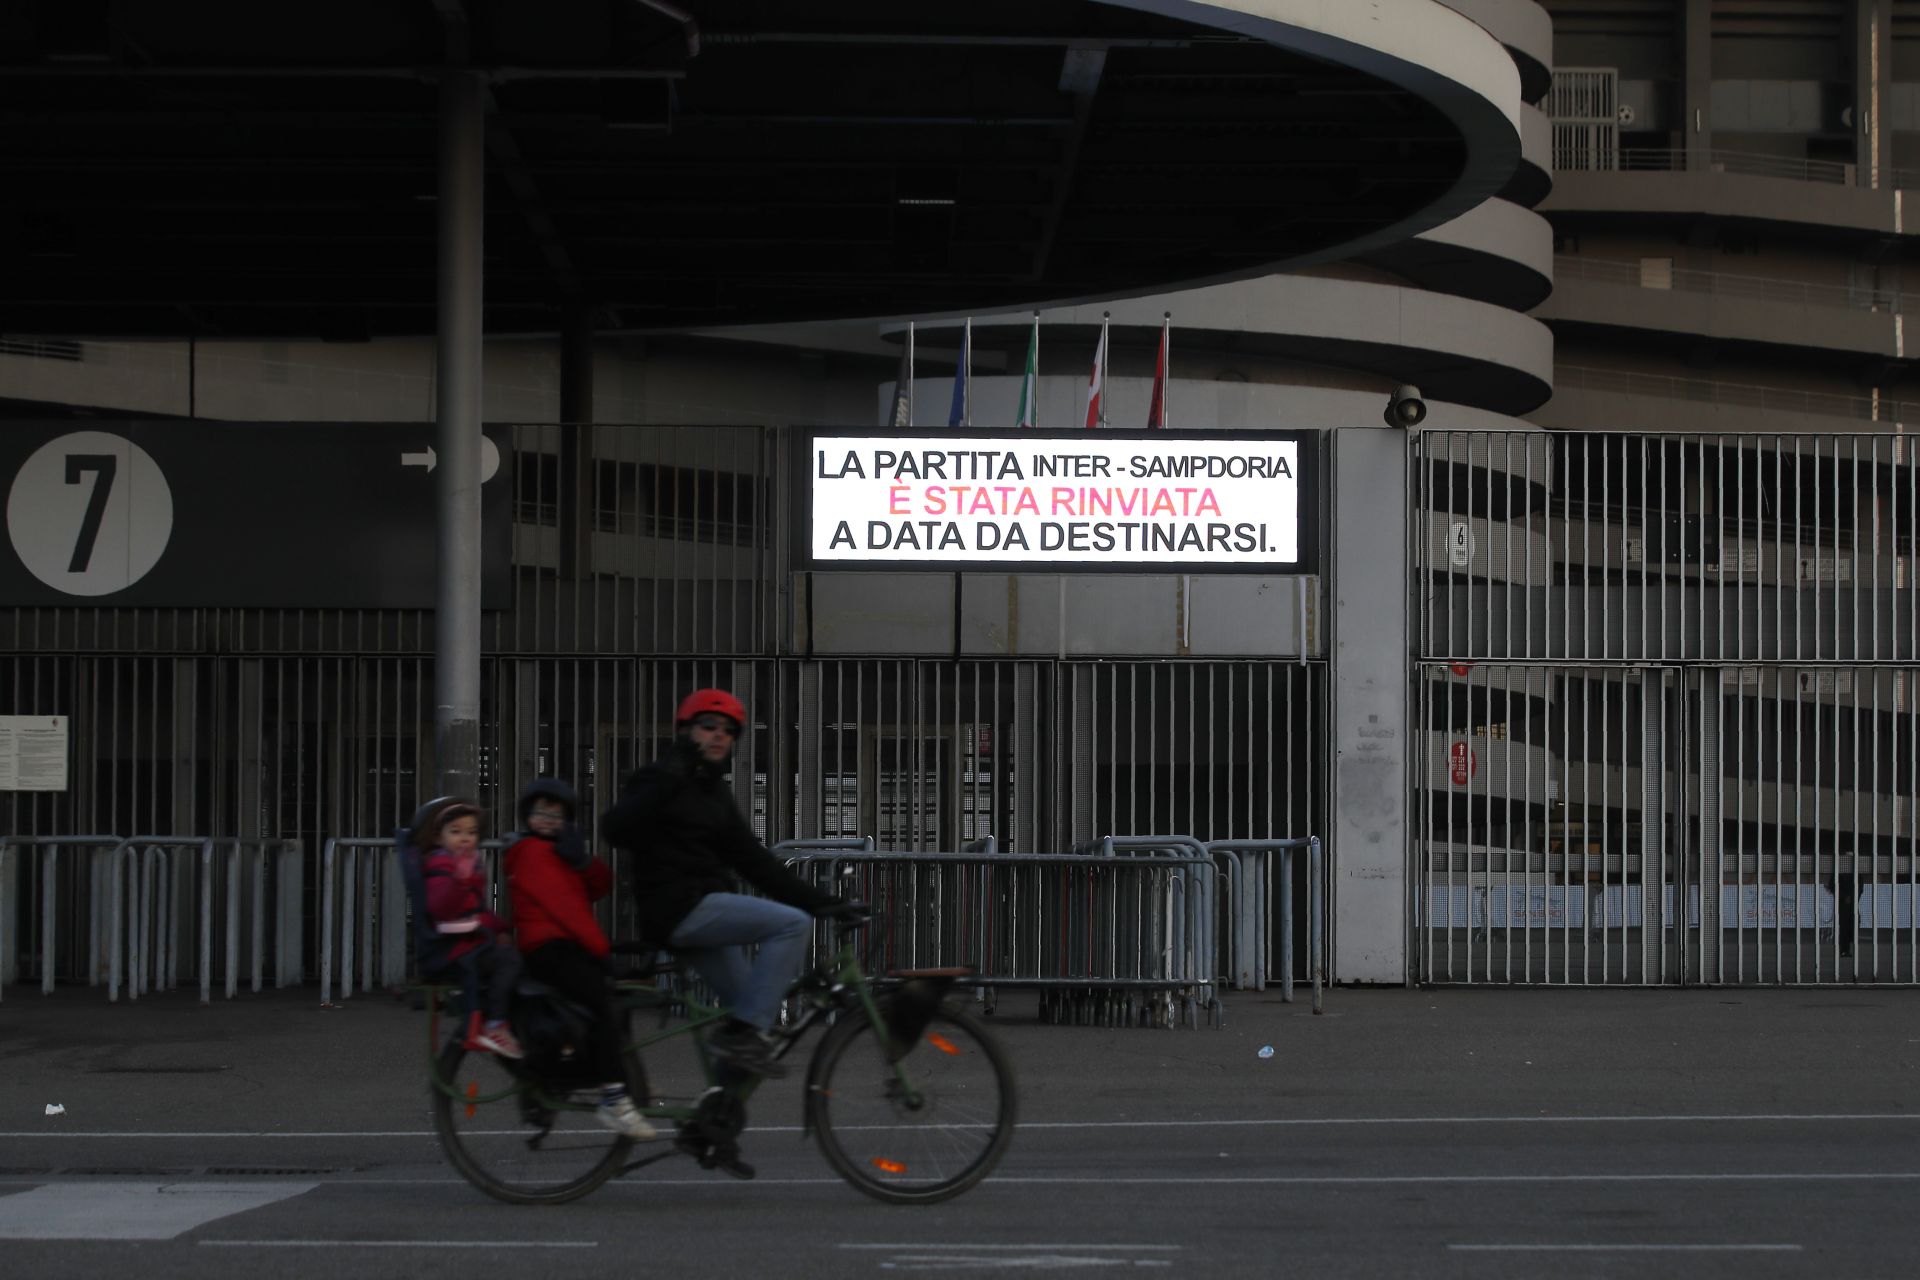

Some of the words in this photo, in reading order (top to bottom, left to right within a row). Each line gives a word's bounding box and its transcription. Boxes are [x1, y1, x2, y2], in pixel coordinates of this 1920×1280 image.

[819, 450, 866, 480] LA
[875, 450, 1024, 481] PARTITA
[1033, 454, 1111, 478] INTER
[1130, 455, 1292, 479] SAMPDORIA
[890, 478, 911, 515] È
[924, 486, 1041, 516] STATA
[1052, 487, 1222, 517] RINVIATA
[65, 455, 117, 573] 7
[829, 521, 857, 550] A
[868, 521, 966, 551] DATA
[977, 521, 1030, 551] DA
[1040, 522, 1277, 553] DESTINARSI.
[1457, 526, 1464, 545] 6
